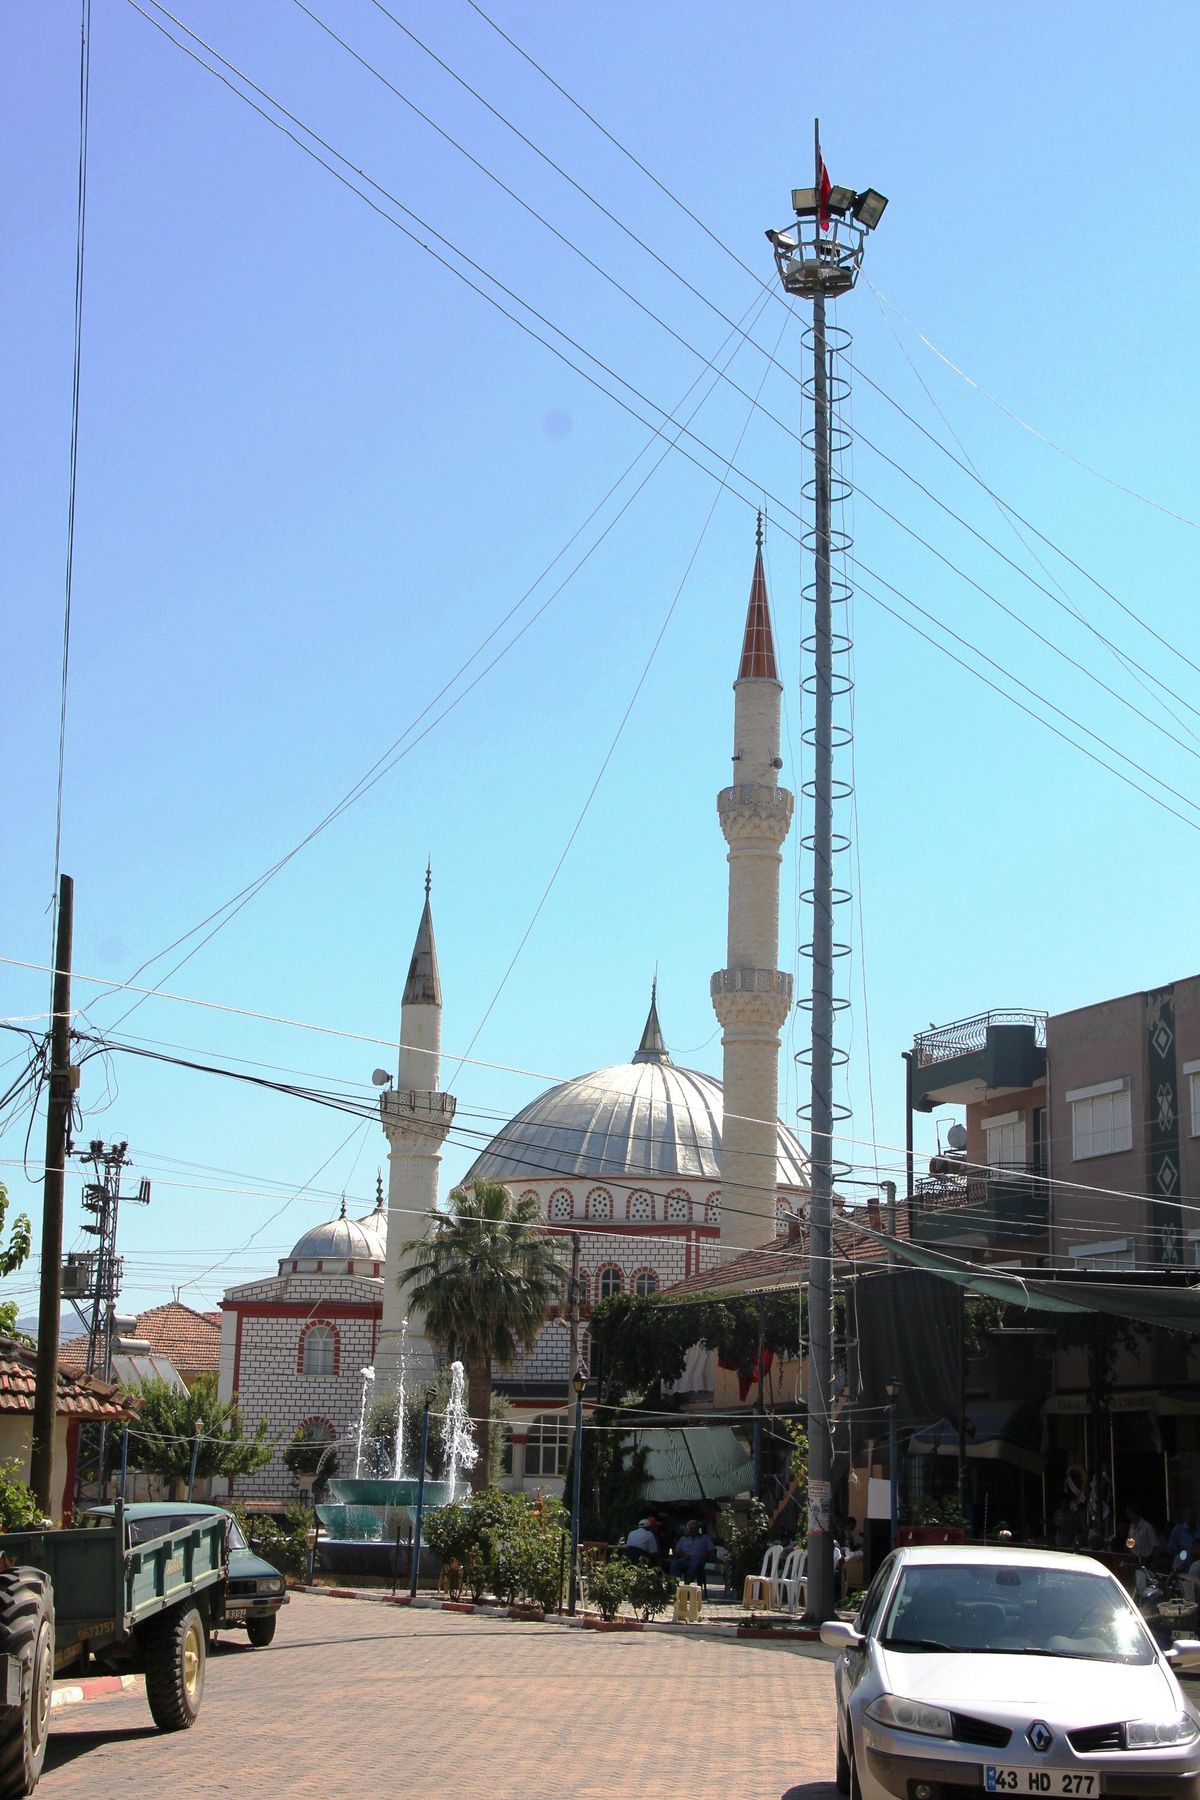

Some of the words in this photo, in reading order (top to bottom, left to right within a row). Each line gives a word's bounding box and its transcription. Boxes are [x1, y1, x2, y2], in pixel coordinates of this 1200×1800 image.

[995, 1770, 1018, 1790] 43
[1028, 1772, 1051, 1792] HD
[1062, 1774, 1095, 1795] 277
